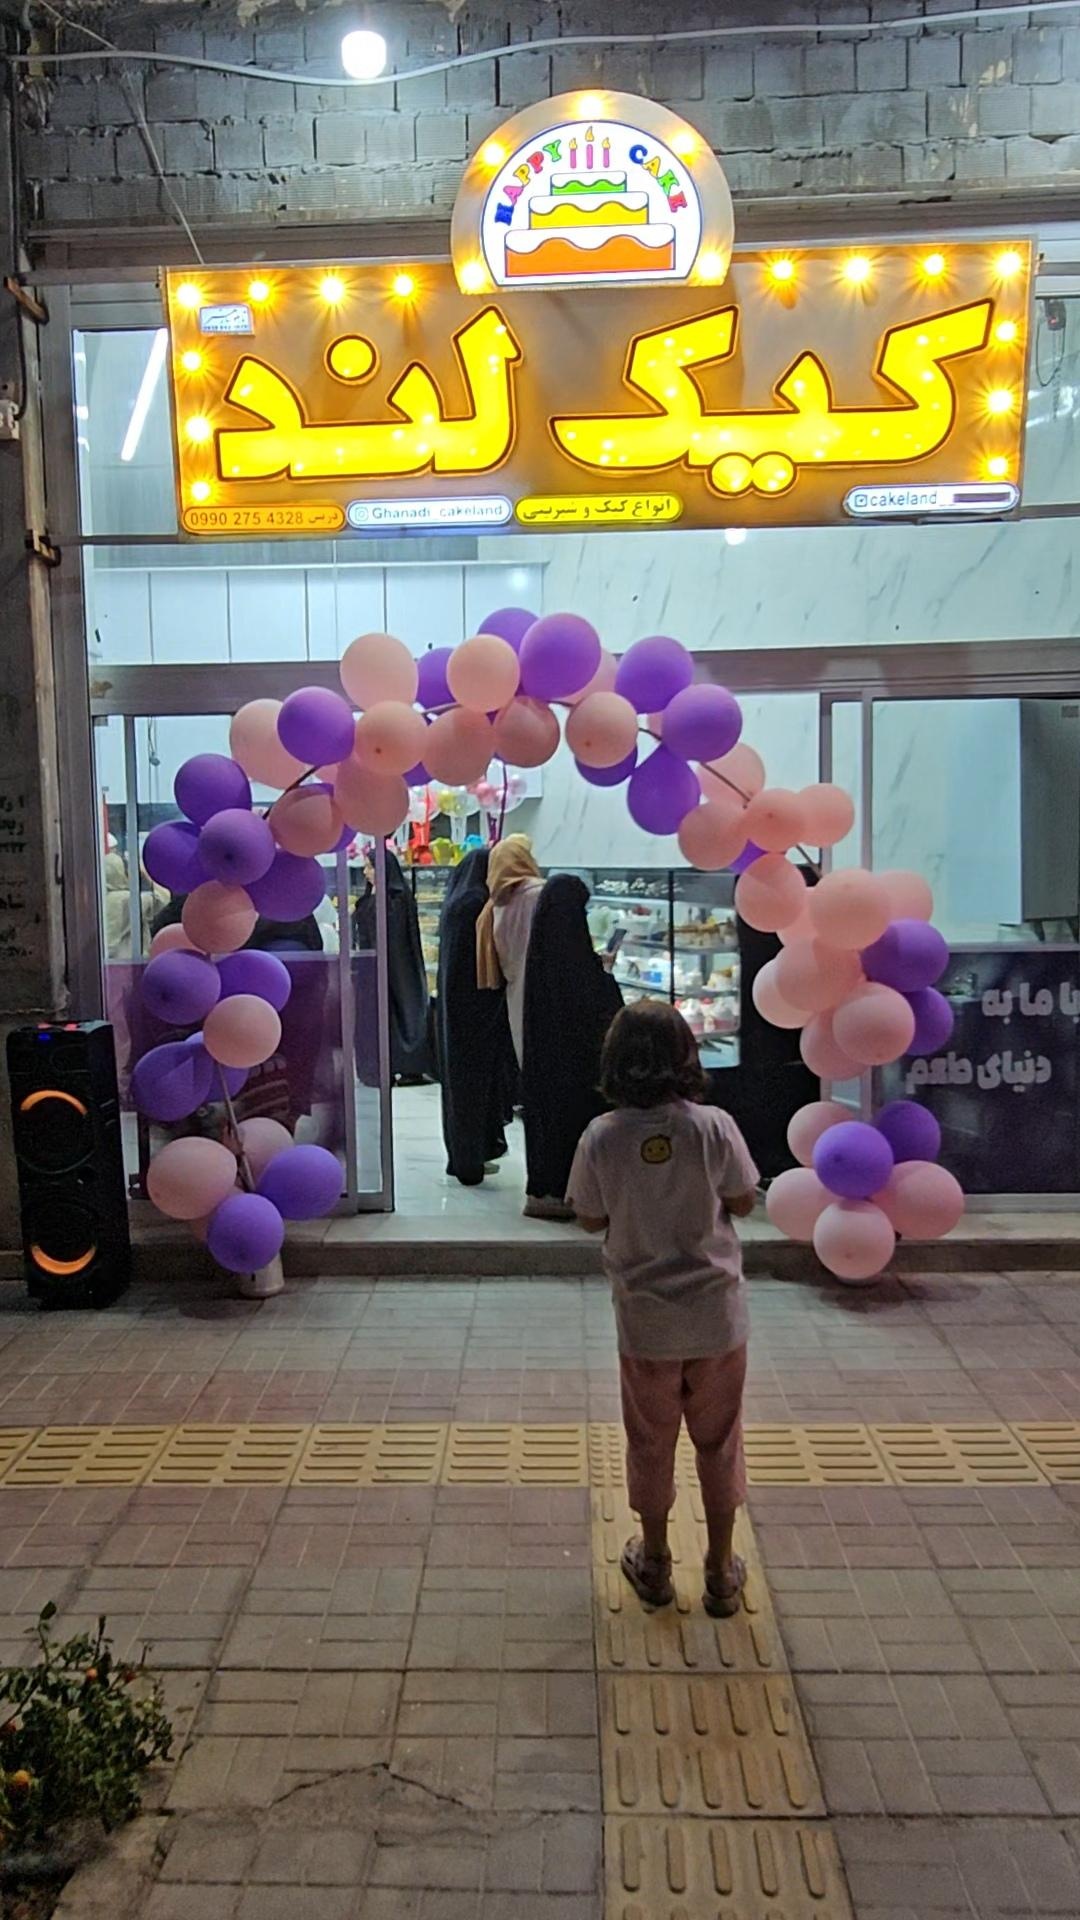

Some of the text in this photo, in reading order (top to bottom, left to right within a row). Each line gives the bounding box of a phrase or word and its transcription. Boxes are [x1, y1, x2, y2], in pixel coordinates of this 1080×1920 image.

[494, 139, 688, 226] HAPPY CAKE
[215, 299, 993, 497] کیک لند
[190, 511, 303, 525] 0990 275 4328
[583, 506, 590, 518] و
[595, 499, 628, 514] کیک
[631, 497, 671, 517] انواع
[981, 989, 1014, 1024] به
[1019, 982, 1054, 1016] ما
[905, 1050, 1052, 1095] دنیای طعم
